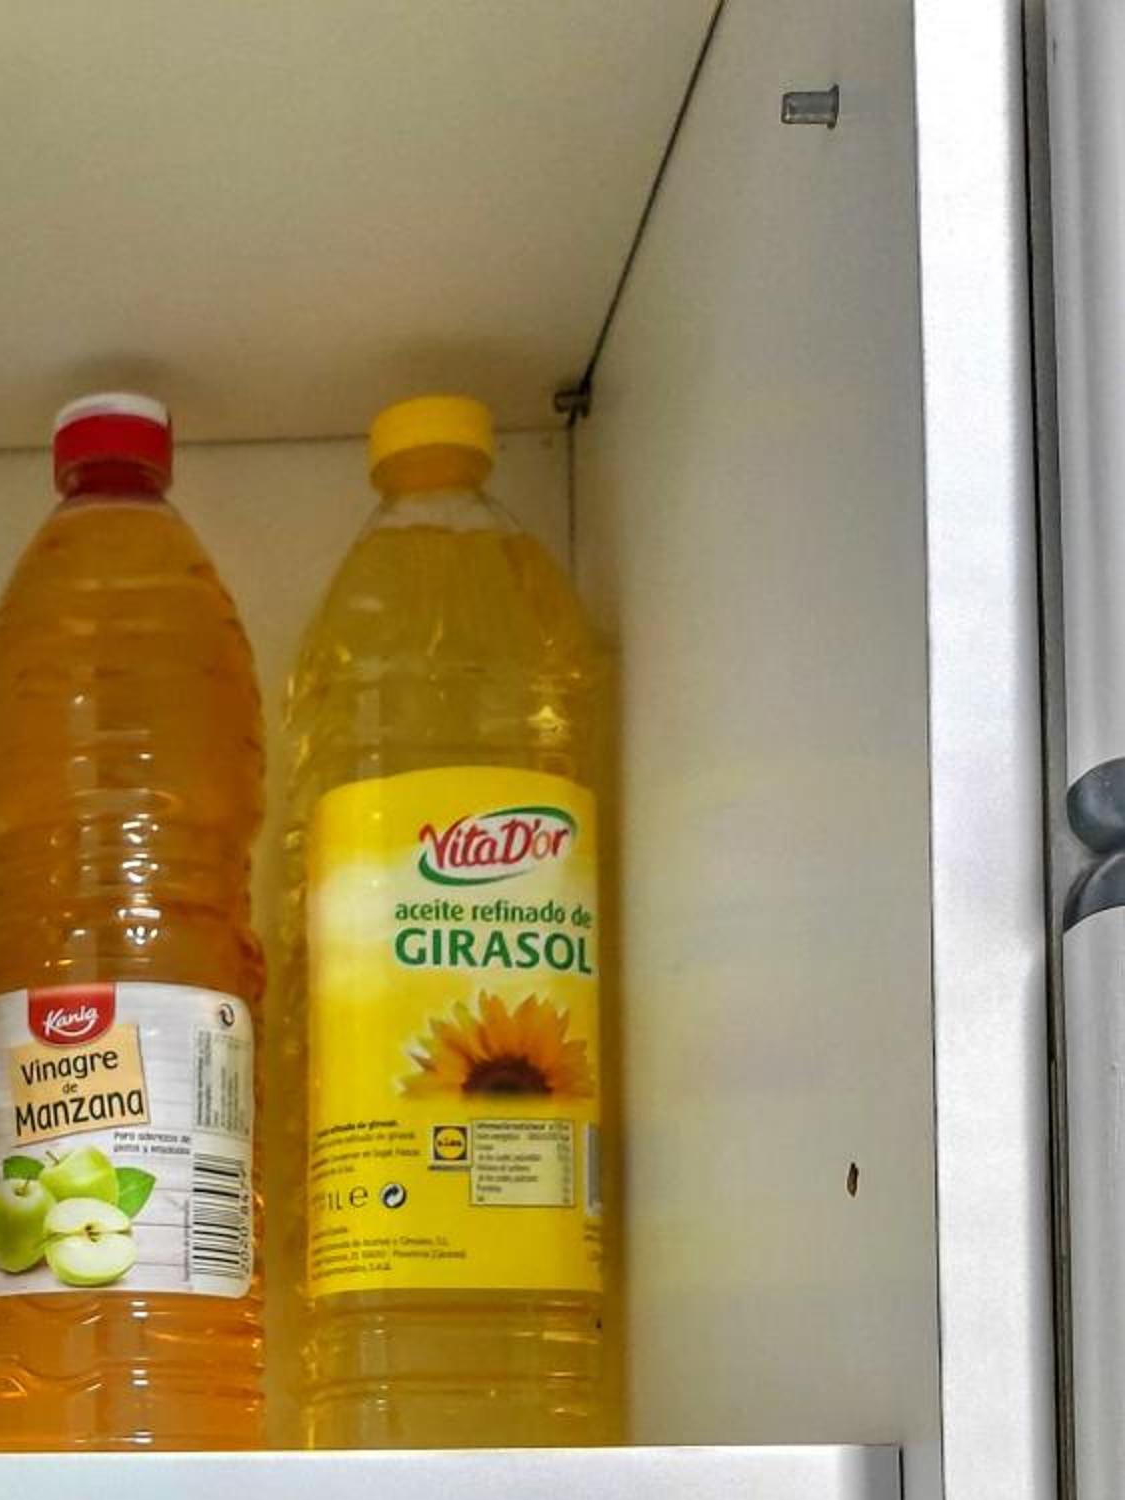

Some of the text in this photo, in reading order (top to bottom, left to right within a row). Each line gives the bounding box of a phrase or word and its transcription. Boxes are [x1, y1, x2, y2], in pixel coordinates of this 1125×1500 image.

[395, 900, 592, 928] aceite refinado de
[395, 928, 592, 974] GIRASOL
[20, 1050, 119, 1086] Vinagre
[62, 1081, 78, 1094] de
[15, 1088, 145, 1136] Manzana
